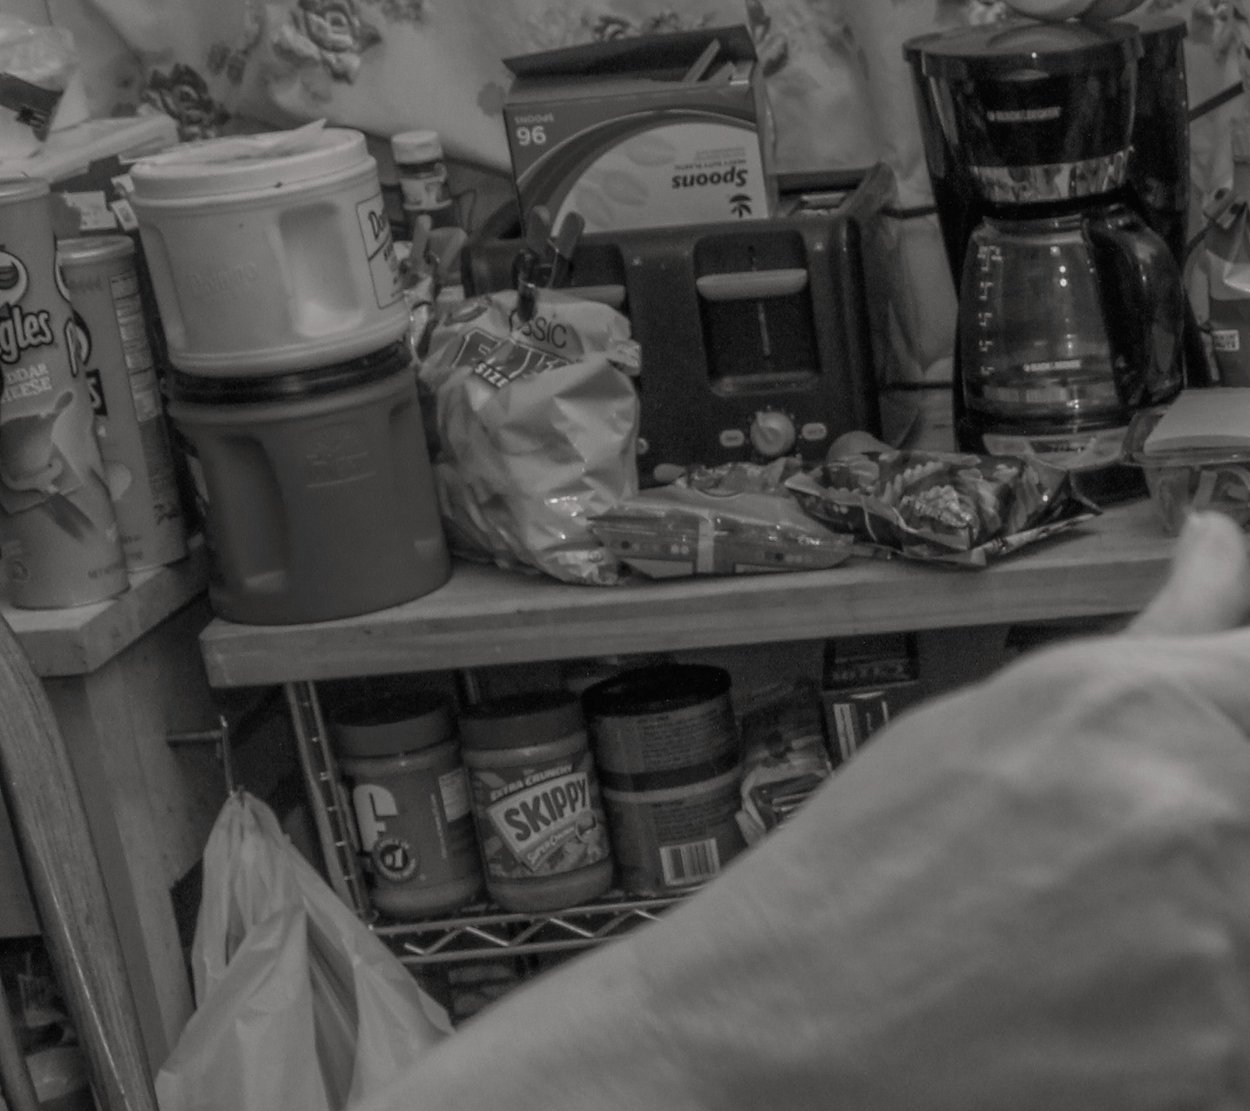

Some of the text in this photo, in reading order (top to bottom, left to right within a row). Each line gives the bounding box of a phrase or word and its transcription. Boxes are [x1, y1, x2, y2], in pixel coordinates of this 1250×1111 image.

[516, 125, 547, 146] 96
[671, 166, 749, 189] Spoons
[504, 778, 587, 841] SKIPPY
